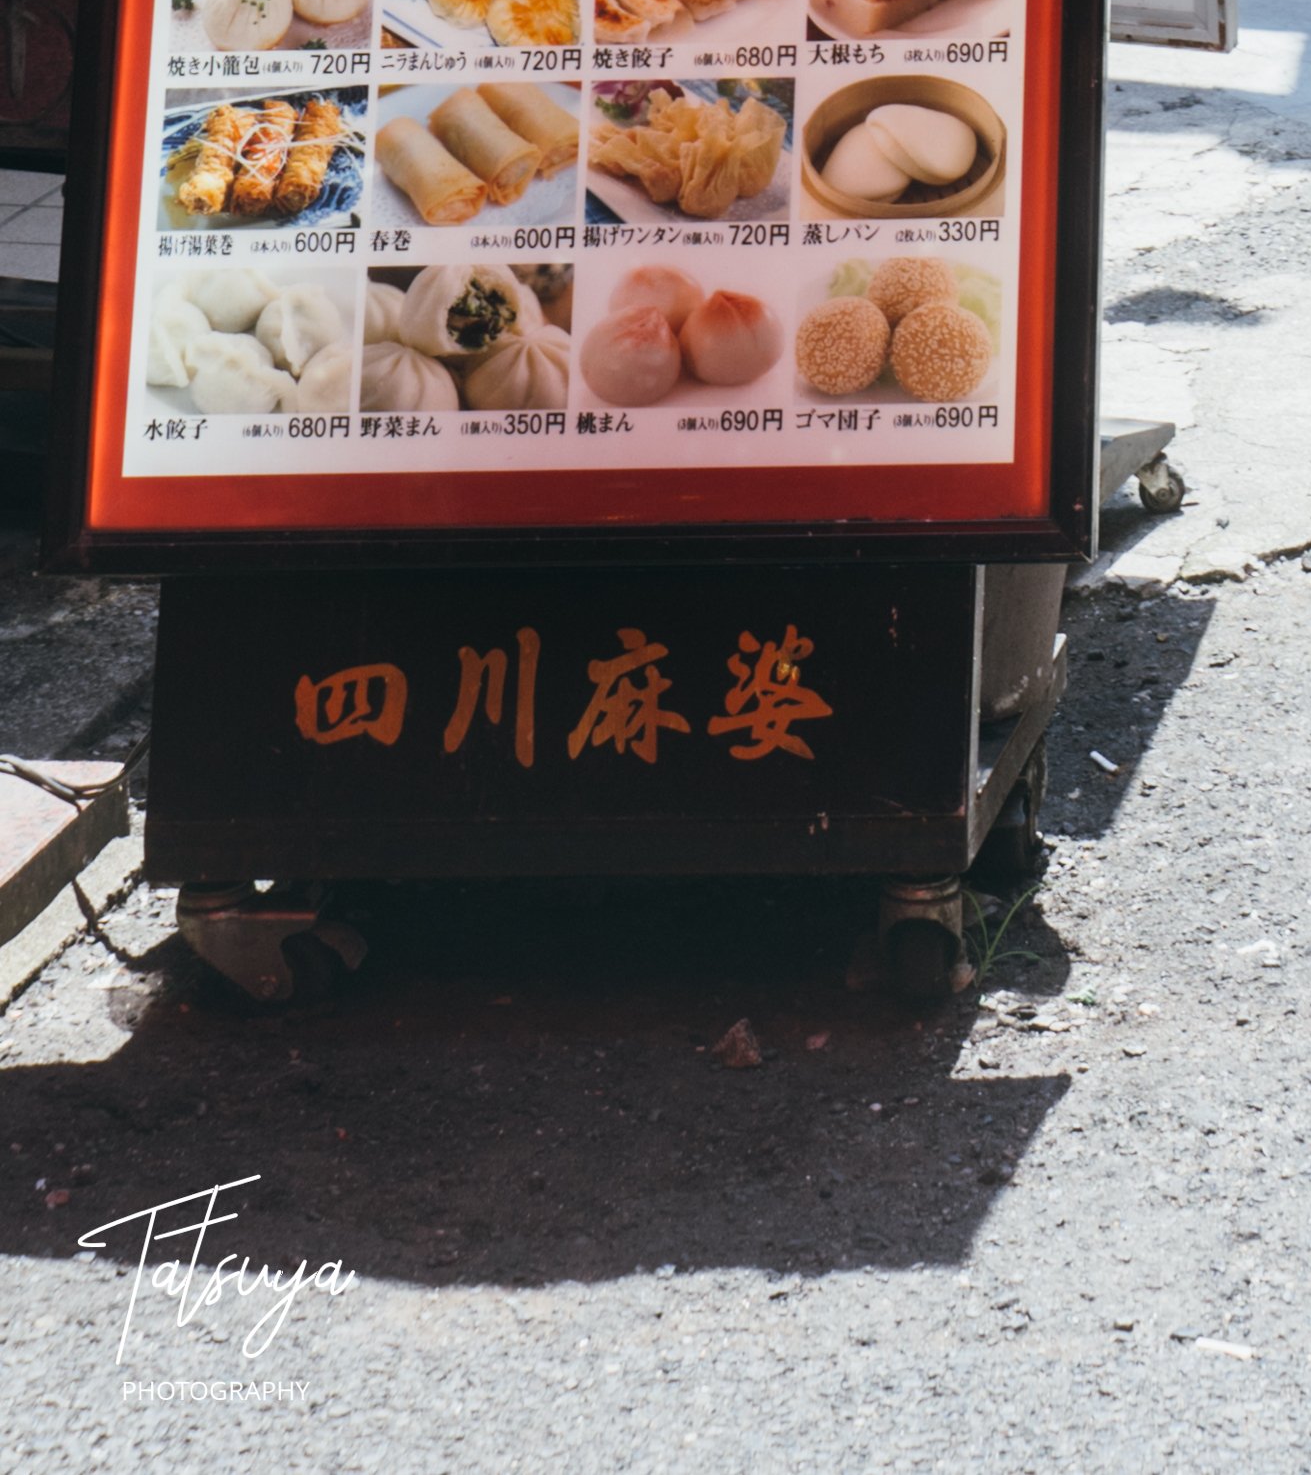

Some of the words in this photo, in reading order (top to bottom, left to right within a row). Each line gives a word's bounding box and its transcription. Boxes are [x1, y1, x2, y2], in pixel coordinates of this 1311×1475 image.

[168, 55, 260, 77] 焼き小籠包
[309, 51, 371, 75] 720円
[381, 51, 468, 73] ニラまんじゅう
[520, 48, 582, 71] 720円
[591, 48, 675, 69] 焼き餃子
[735, 44, 798, 67] 680円
[808, 43, 886, 65] 大根もち
[946, 41, 1008, 63] 690円
[294, 231, 356, 254] 600円
[369, 229, 412, 253] 春巻
[513, 225, 576, 249] 600円
[583, 225, 682, 248] 揚げワンタン
[728, 223, 790, 246] 720円
[802, 221, 881, 245] 蒸しパン
[937, 219, 1000, 242] 330円
[143, 418, 208, 442] 水餃子
[287, 415, 351, 438] 680円
[359, 415, 442, 438] 野菜まん
[502, 412, 566, 436] 350円
[575, 412, 635, 435] 桃まん
[720, 408, 783, 432] 690円
[794, 409, 881, 432] ゴマ団子
[935, 405, 999, 429] 690円
[294, 623, 834, 769] 四川麻婆
